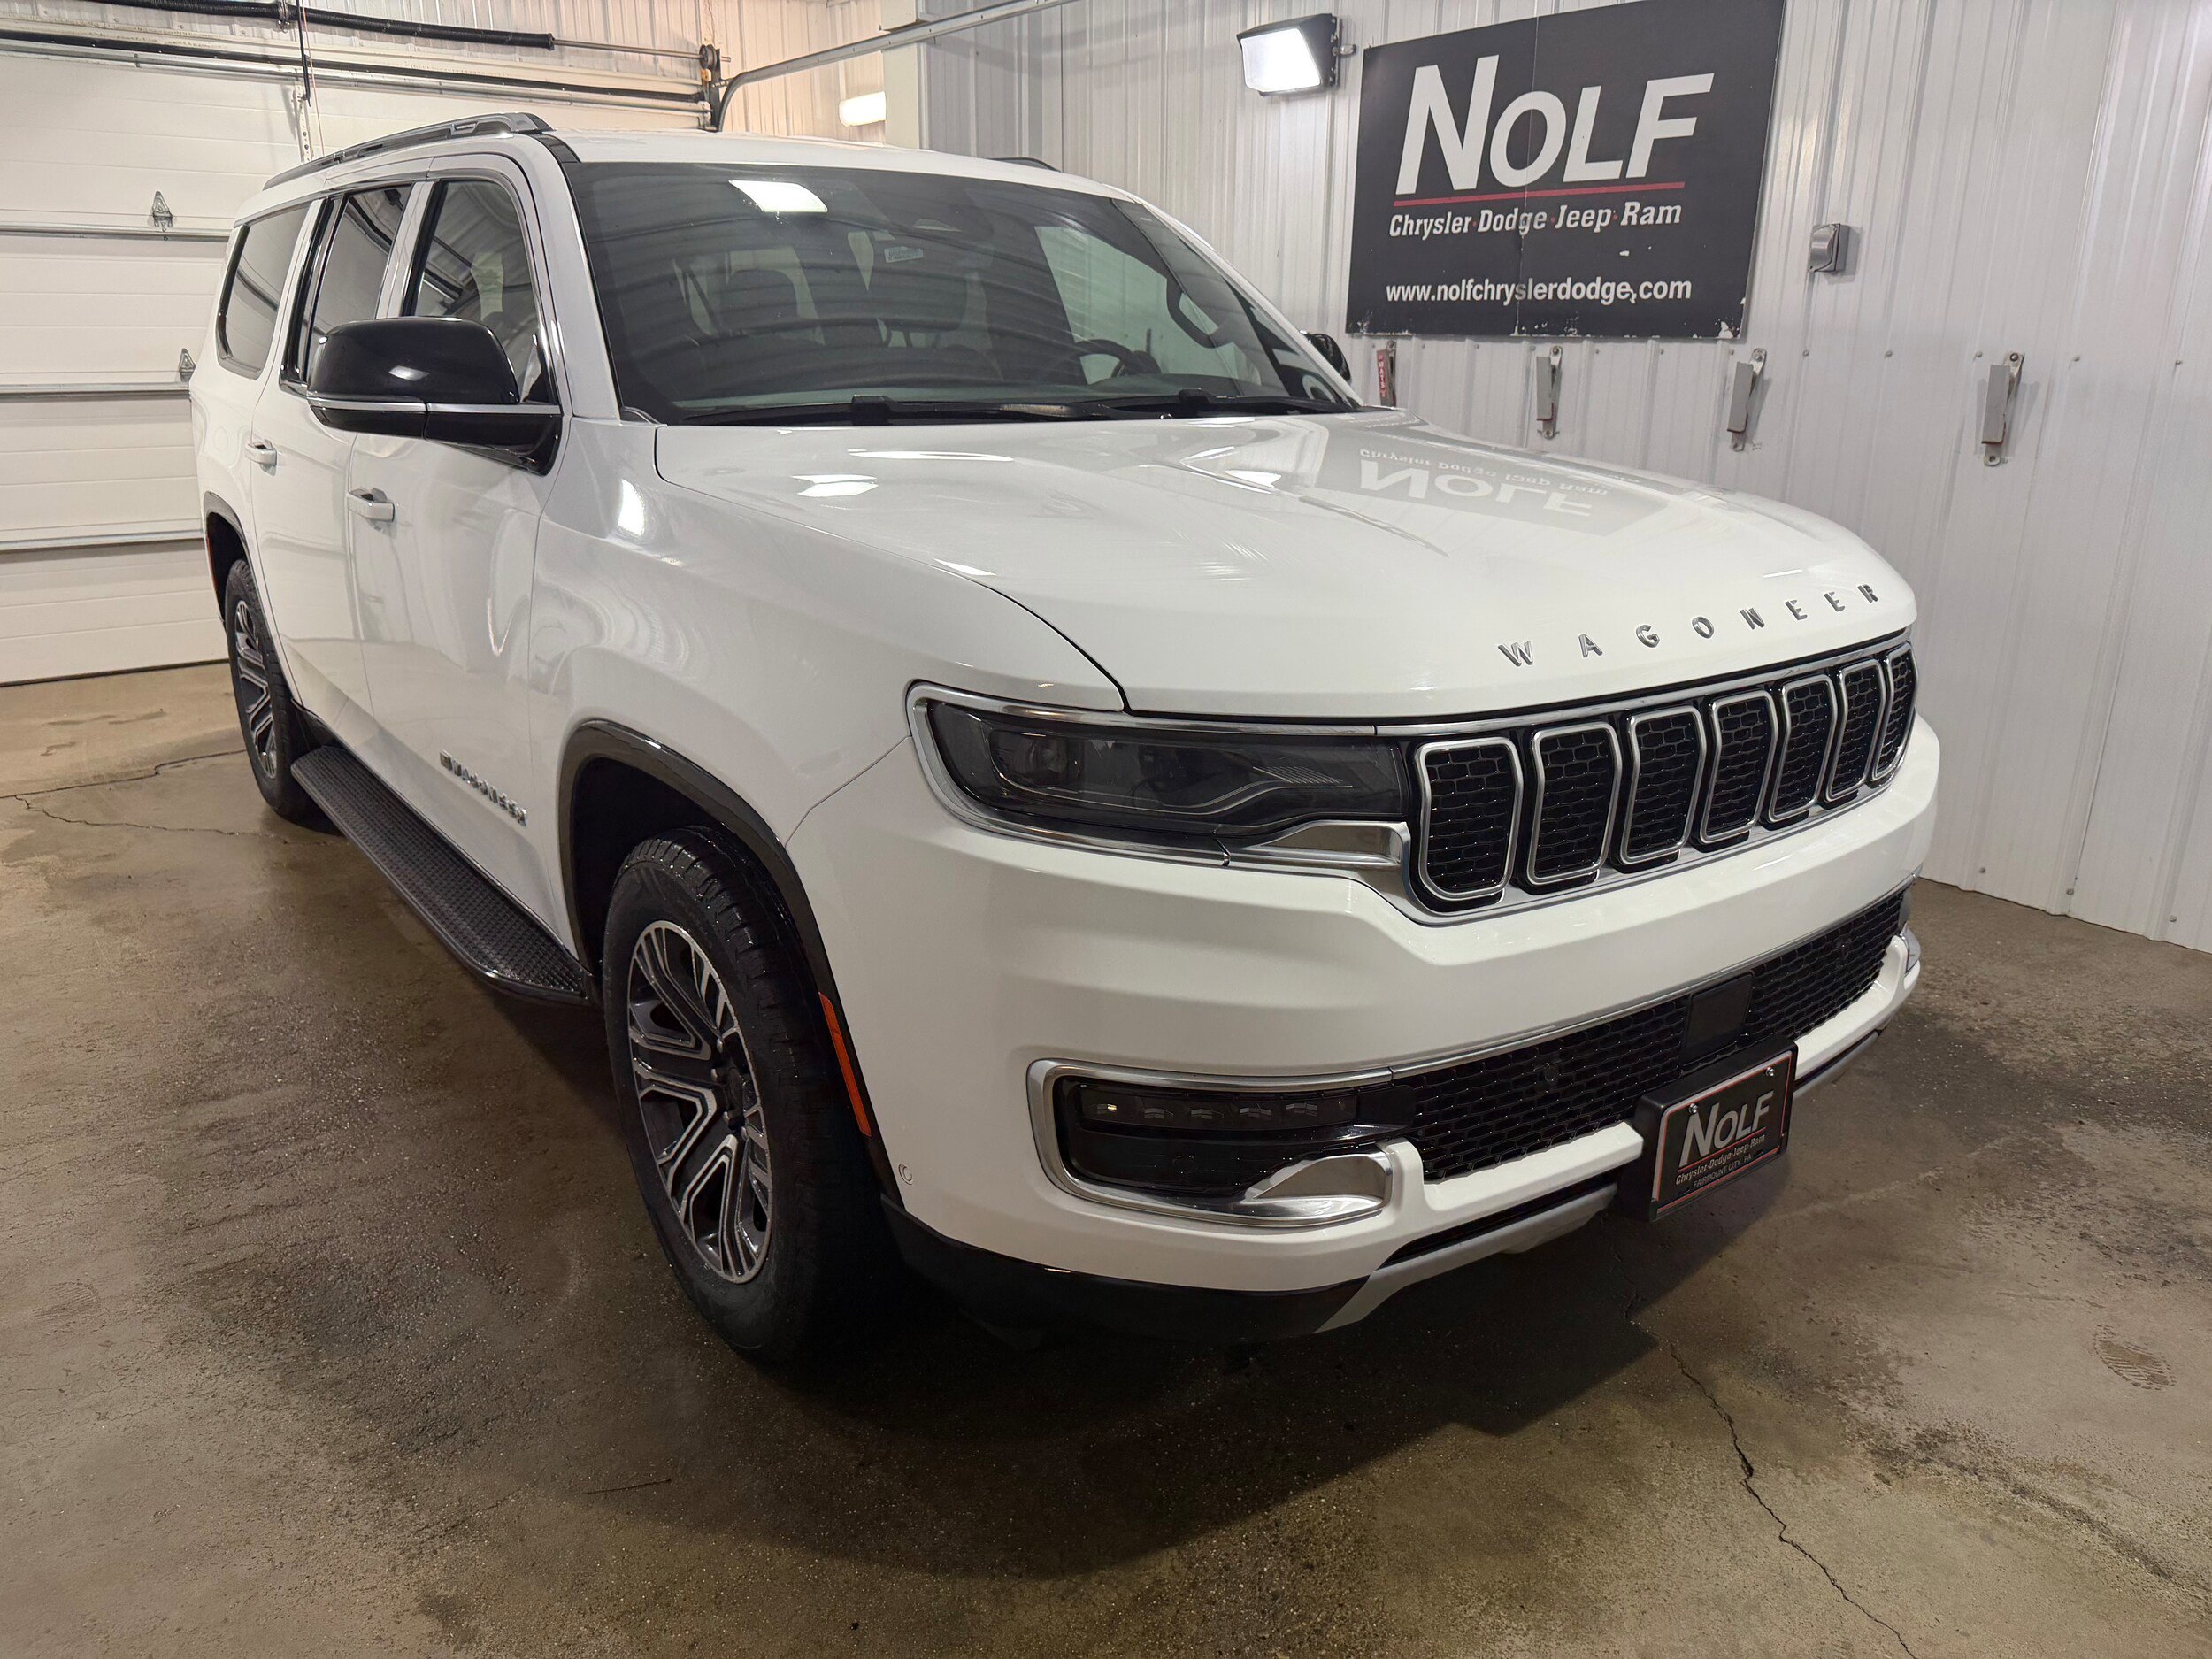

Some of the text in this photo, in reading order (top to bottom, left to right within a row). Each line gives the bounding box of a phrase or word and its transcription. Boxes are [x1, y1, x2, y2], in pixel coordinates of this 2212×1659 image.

[1395, 54, 1715, 195] NOLF
[1389, 201, 1681, 241] Chrysler Dodge Jeep Ram
[1386, 276, 1693, 305] www.nolfchryslerdodge.com
[1498, 584, 1879, 667] WAGONEER
[1678, 1090, 1774, 1168] NOLF
